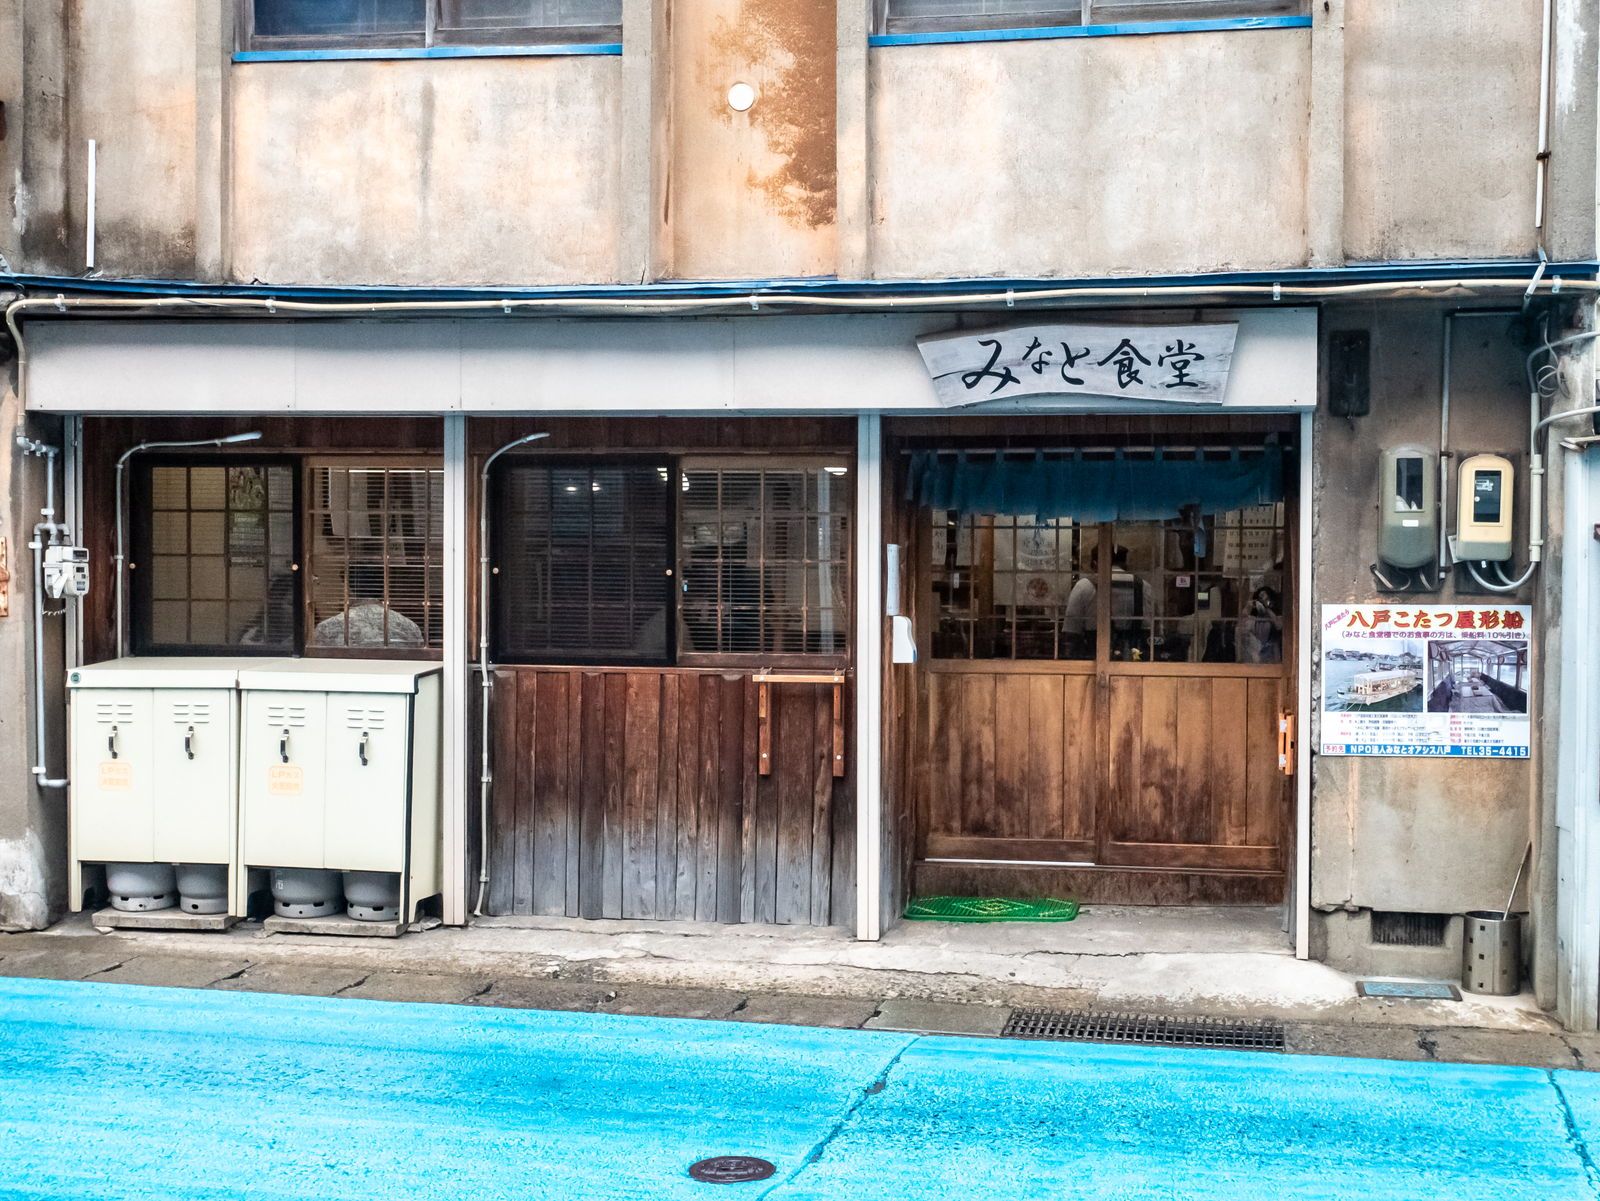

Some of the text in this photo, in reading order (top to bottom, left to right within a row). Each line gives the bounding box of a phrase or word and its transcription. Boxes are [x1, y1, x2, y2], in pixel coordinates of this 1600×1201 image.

[962, 336, 1205, 394] みなと食堂
[1346, 609, 1525, 629] 八戸こたつ屋形船
[1461, 746, 1527, 756] TEL35-4415
